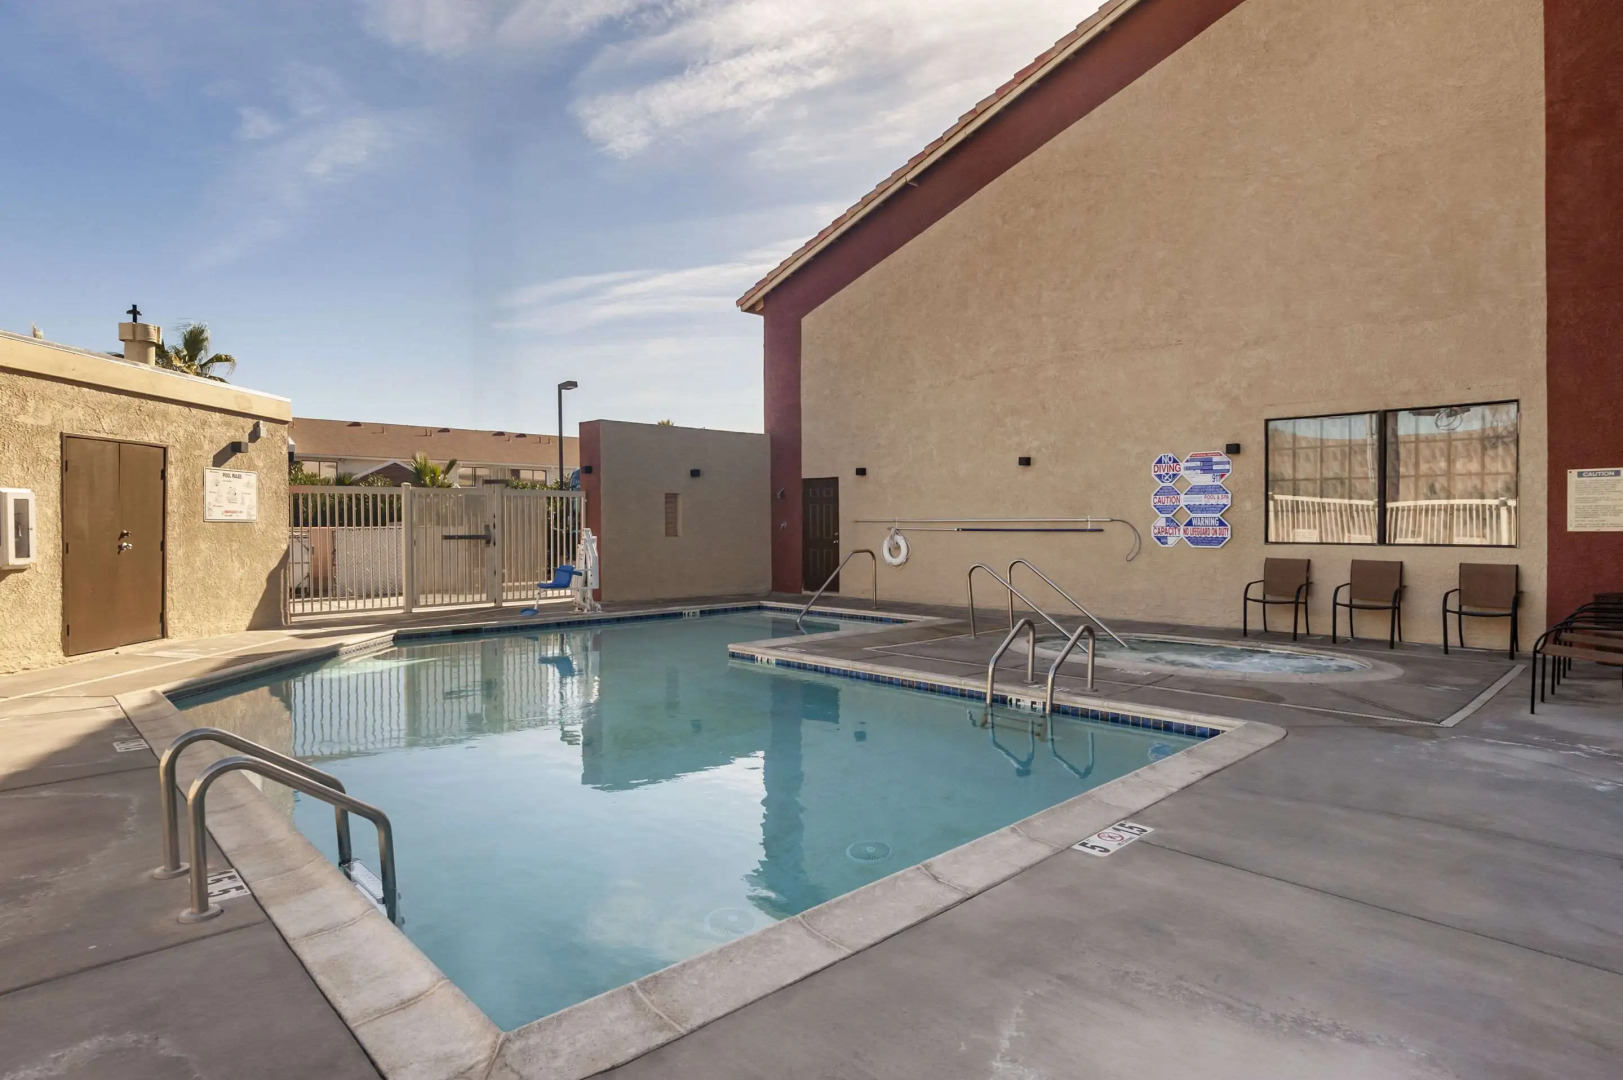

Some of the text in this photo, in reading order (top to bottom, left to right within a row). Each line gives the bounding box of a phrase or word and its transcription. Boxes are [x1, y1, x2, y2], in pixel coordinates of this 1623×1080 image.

[1161, 455, 1173, 464] NO
[1153, 463, 1181, 473] DIVING
[1153, 496, 1180, 504] CAUTION
[1192, 517, 1219, 526] WARNING
[1153, 526, 1181, 535] CAPACITY
[1183, 527, 1229, 535] NO LIFEGUARD ON DUTY
[1078, 841, 1111, 853] 5
